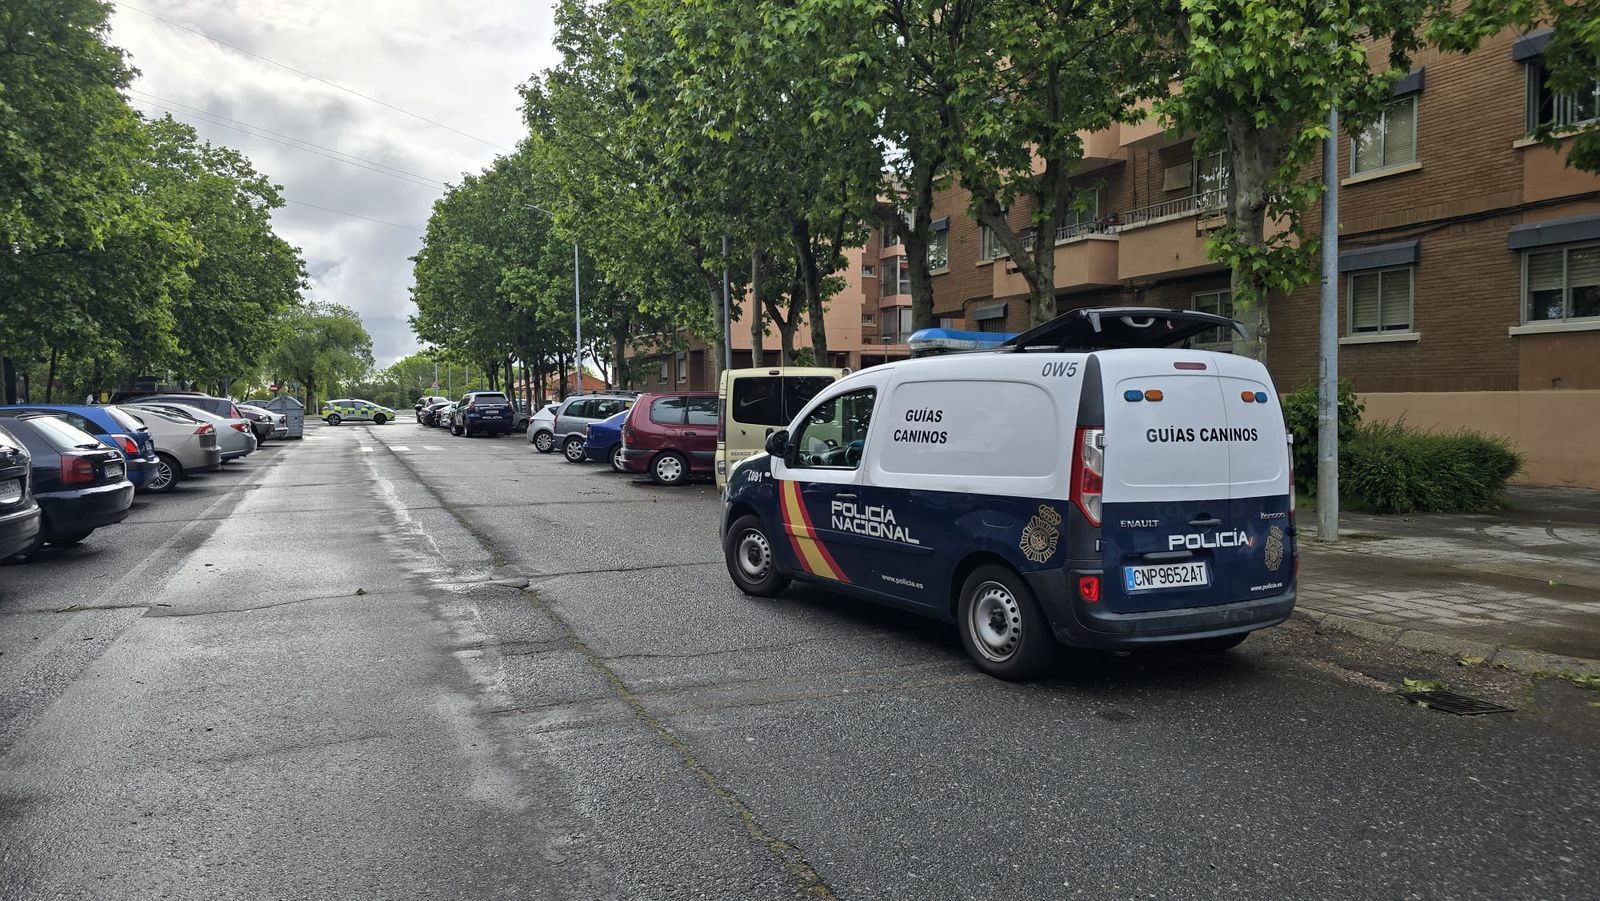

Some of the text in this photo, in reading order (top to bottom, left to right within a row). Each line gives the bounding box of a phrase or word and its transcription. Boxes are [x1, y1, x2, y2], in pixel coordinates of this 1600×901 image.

[905, 406, 943, 423] GUÍAS
[893, 429, 948, 444] CANINOS
[1146, 425, 1258, 443] GUÍAS CANINOS
[831, 500, 896, 525] POLICÍA
[831, 515, 920, 544] NACIONAL
[1120, 519, 1159, 528] ENAULT
[1168, 528, 1249, 551] POLICÍA
[880, 574, 924, 589] www.policia.es
[1133, 565, 1203, 586] CNP9652AT
